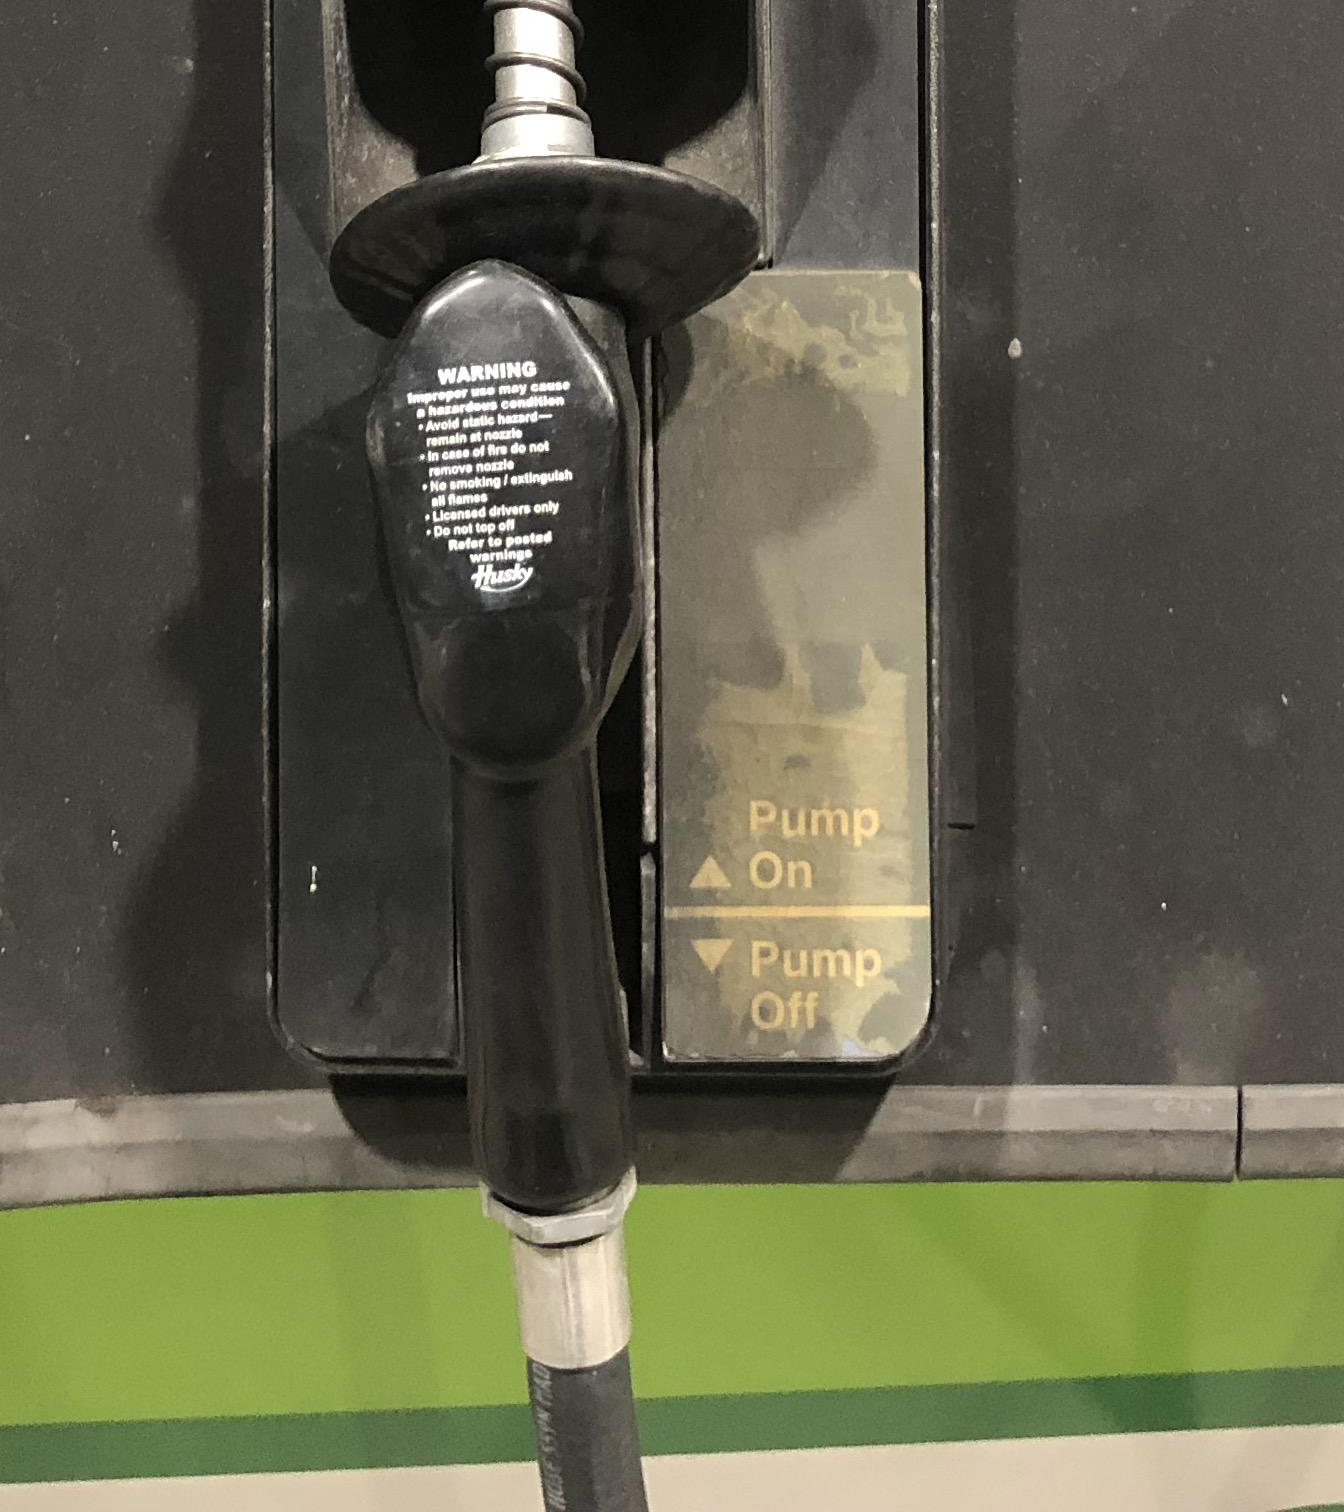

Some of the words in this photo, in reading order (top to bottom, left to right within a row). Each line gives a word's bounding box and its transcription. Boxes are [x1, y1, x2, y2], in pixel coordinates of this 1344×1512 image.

[437, 361, 537, 385] WARNING
[471, 386, 496, 398] use
[499, 383, 527, 396] may
[530, 380, 570, 392] cause
[416, 408, 426, 419] a
[428, 399, 498, 417] hazardous
[501, 395, 565, 410] condition
[425, 417, 459, 432] Avoid
[462, 414, 495, 428] static
[426, 433, 467, 448] remain
[470, 430, 482, 443] at
[484, 427, 523, 442] nozzle
[427, 449, 439, 462] In
[441, 447, 470, 460] case
[472, 444, 485, 458] of
[487, 443, 507, 456] fire
[510, 441, 527, 454] do
[529, 440, 549, 453] not
[429, 462, 473, 477] remove
[476, 458, 515, 473] nozzle
[430, 479, 447, 493] No
[449, 475, 501, 490] smoking
[511, 468, 573, 485] extinguish
[431, 495, 446, 507] all
[448, 492, 488, 505] flames
[432, 506, 486, 522] Licensed
[489, 502, 531, 517] drivers
[534, 500, 559, 514] only
[433, 524, 450, 538] Do
[453, 522, 473, 536] not
[476, 522, 496, 536] top
[498, 518, 516, 531] off
[448, 537, 485, 551] Refer
[488, 535, 502, 547] to
[506, 531, 553, 548] posted
[469, 548, 533, 564] warnings
[470, 563, 534, 592] Husky
[749, 800, 880, 848] Pump
[749, 851, 812, 889] On
[751, 940, 882, 988] Pump
[751, 990, 819, 1030] Off
